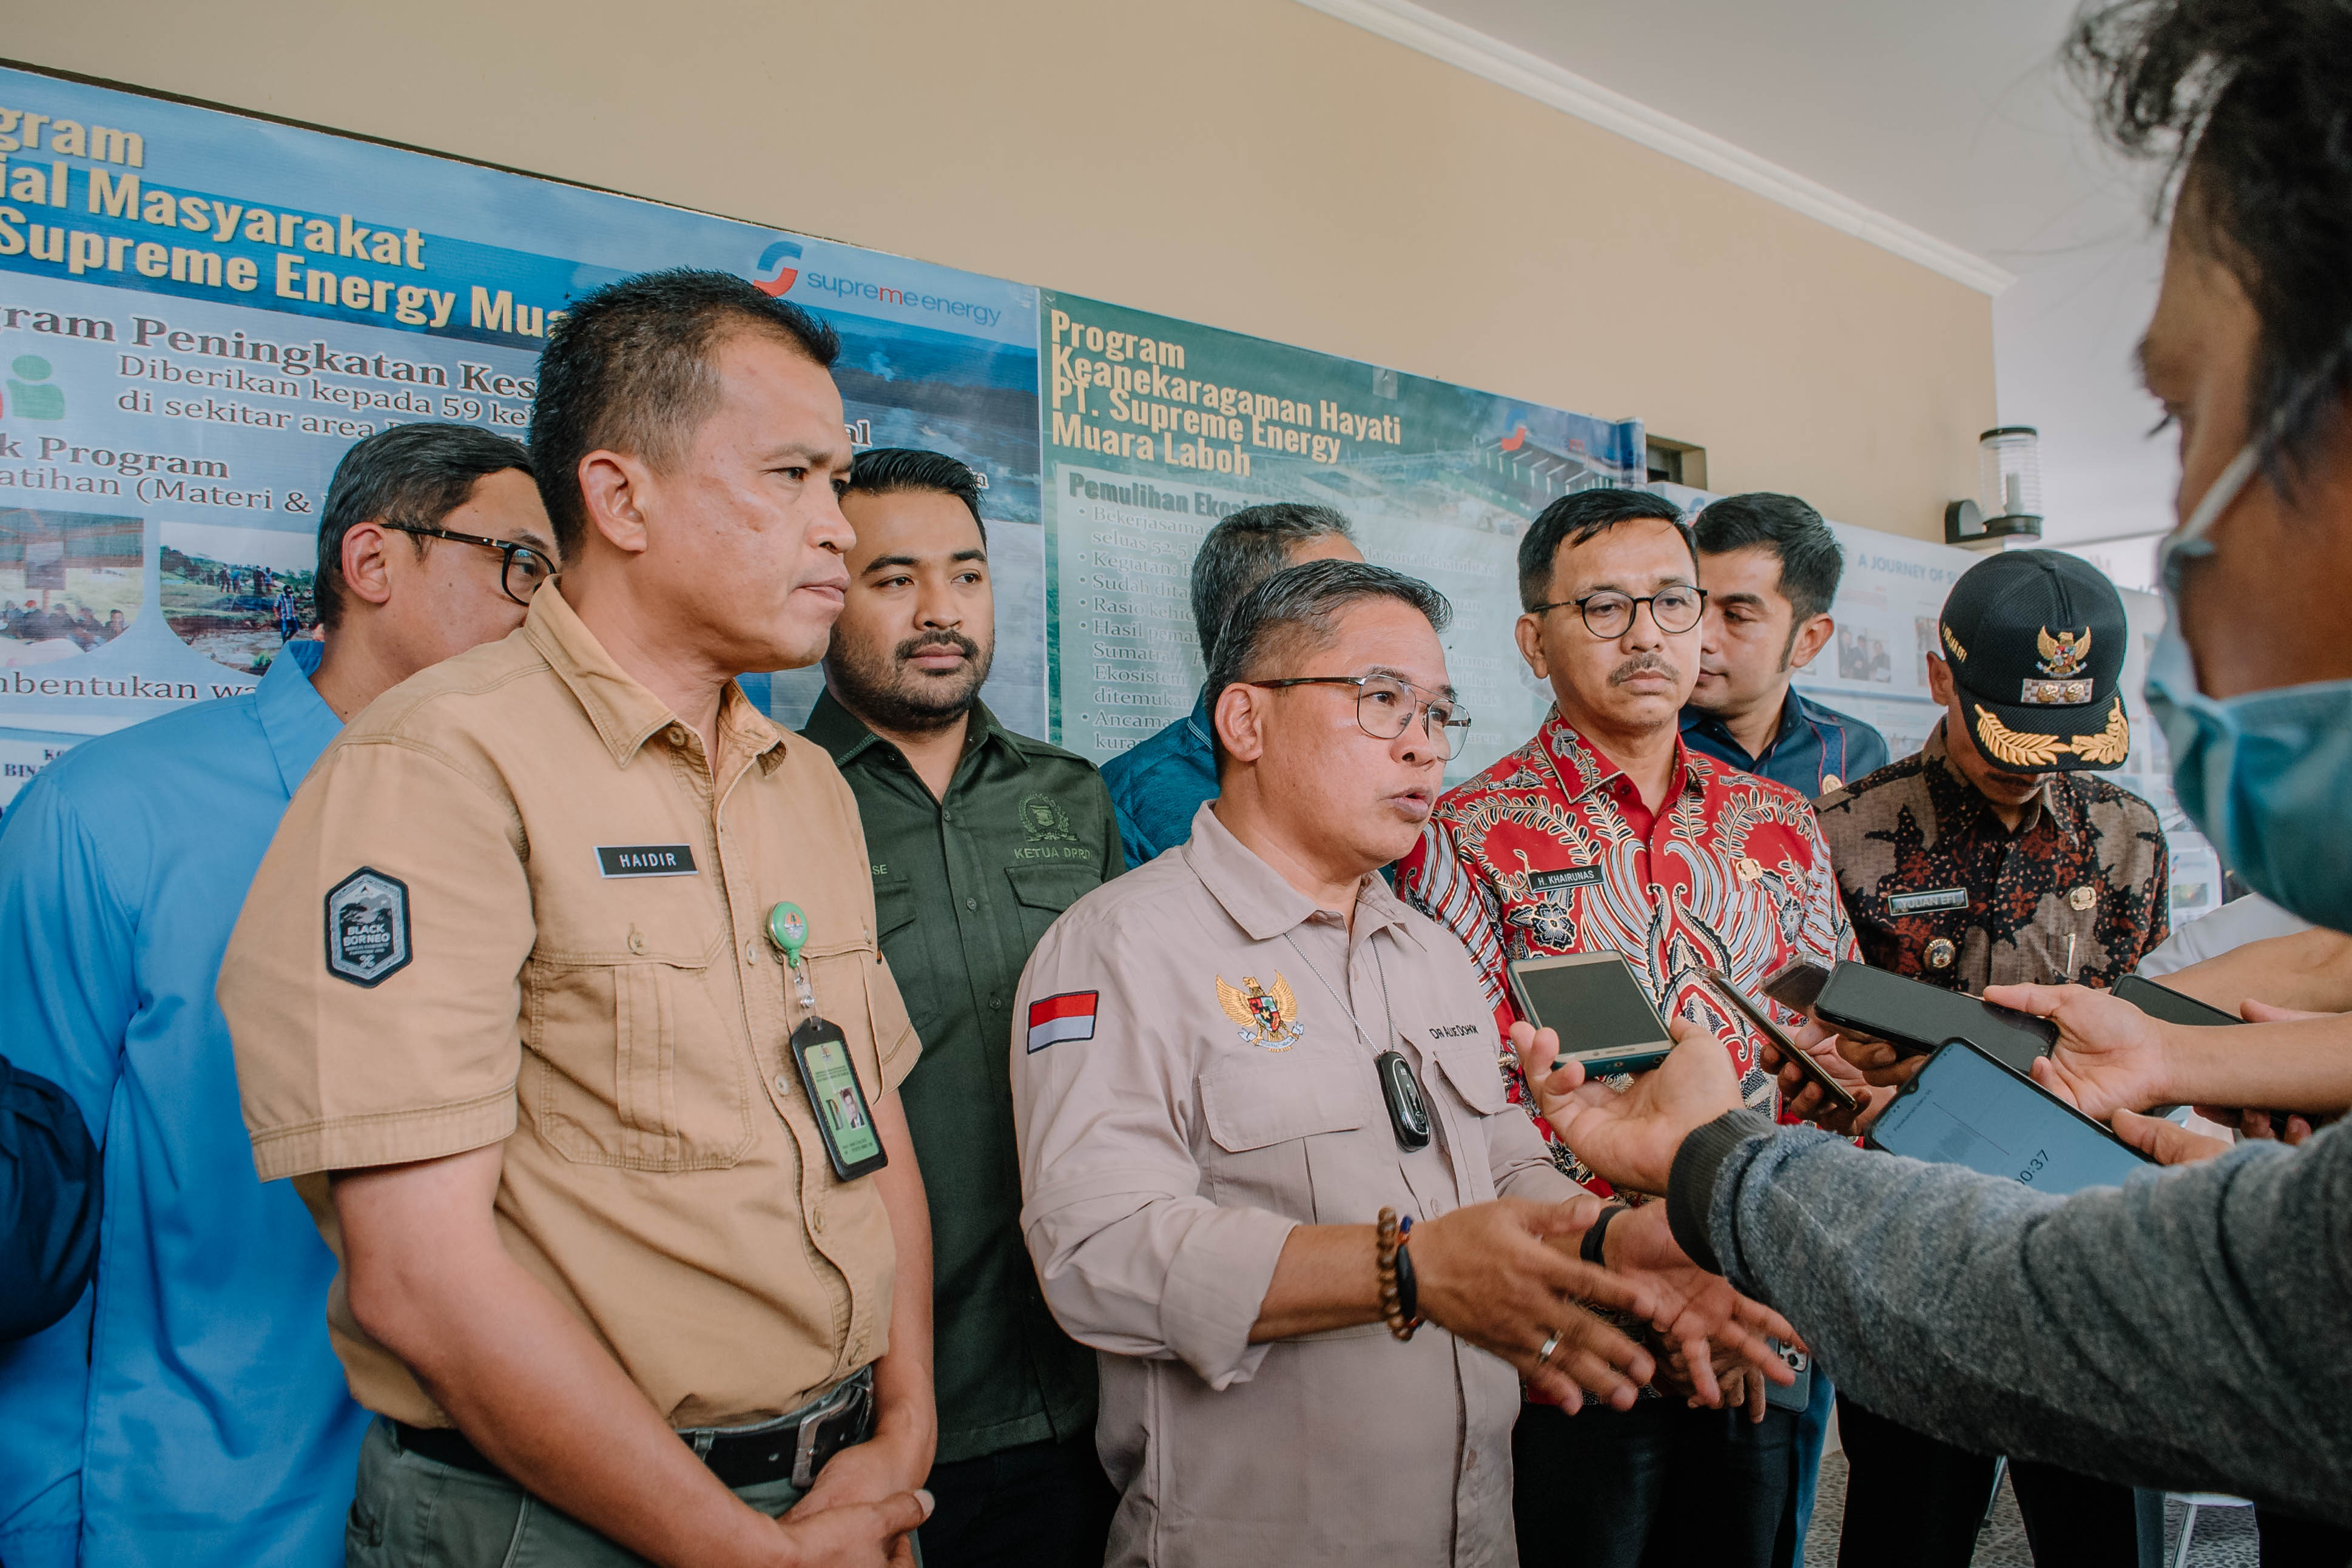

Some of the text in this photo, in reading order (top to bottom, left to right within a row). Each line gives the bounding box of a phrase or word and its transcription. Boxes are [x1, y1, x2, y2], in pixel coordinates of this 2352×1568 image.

[89, 167, 425, 271] Masyarakat
[0, 206, 258, 292] Supreme
[276, 252, 456, 329] Energy
[806, 271, 1002, 328] supreme energy
[132, 317, 447, 388] Peningkatan
[1051, 309, 1185, 370] Program
[119, 354, 299, 397] Diberikan
[312, 380, 431, 414] kepada
[443, 397, 481, 419] 59
[1051, 343, 1401, 445] Keanekaragaman Hayati
[118, 390, 374, 438] di sekitar area
[1051, 375, 1341, 464] PT. Supreme Energy
[37, 436, 229, 479] Program
[1051, 411, 1251, 477] Muara Laboh
[136, 477, 272, 510] (Materi
[285, 491, 312, 515] &
[1069, 472, 1188, 514] Pemulihan
[1094, 506, 1204, 535] Bekerjasama
[1092, 531, 1146, 549] seluas
[1152, 542, 1187, 558] 52.5
[1093, 551, 1177, 575] Kegiatan:
[1858, 553, 1867, 568] A
[1871, 556, 1927, 578] JOURNEY
[1093, 574, 1150, 593] Sudah
[1094, 597, 1144, 614] Rasio
[1094, 620, 1142, 637] Hasil
[1093, 642, 1170, 661] Sumatra
[1094, 665, 1185, 685] Ekosistem
[1094, 688, 1191, 708] ditemukan
[619, 852, 677, 868] HAIDIR
[1014, 847, 1092, 860] KETUA DPRD
[1537, 870, 1595, 886] H. KHAIRUNAS
[343, 932, 391, 946] BORNEO
[348, 923, 385, 935] BLACK
